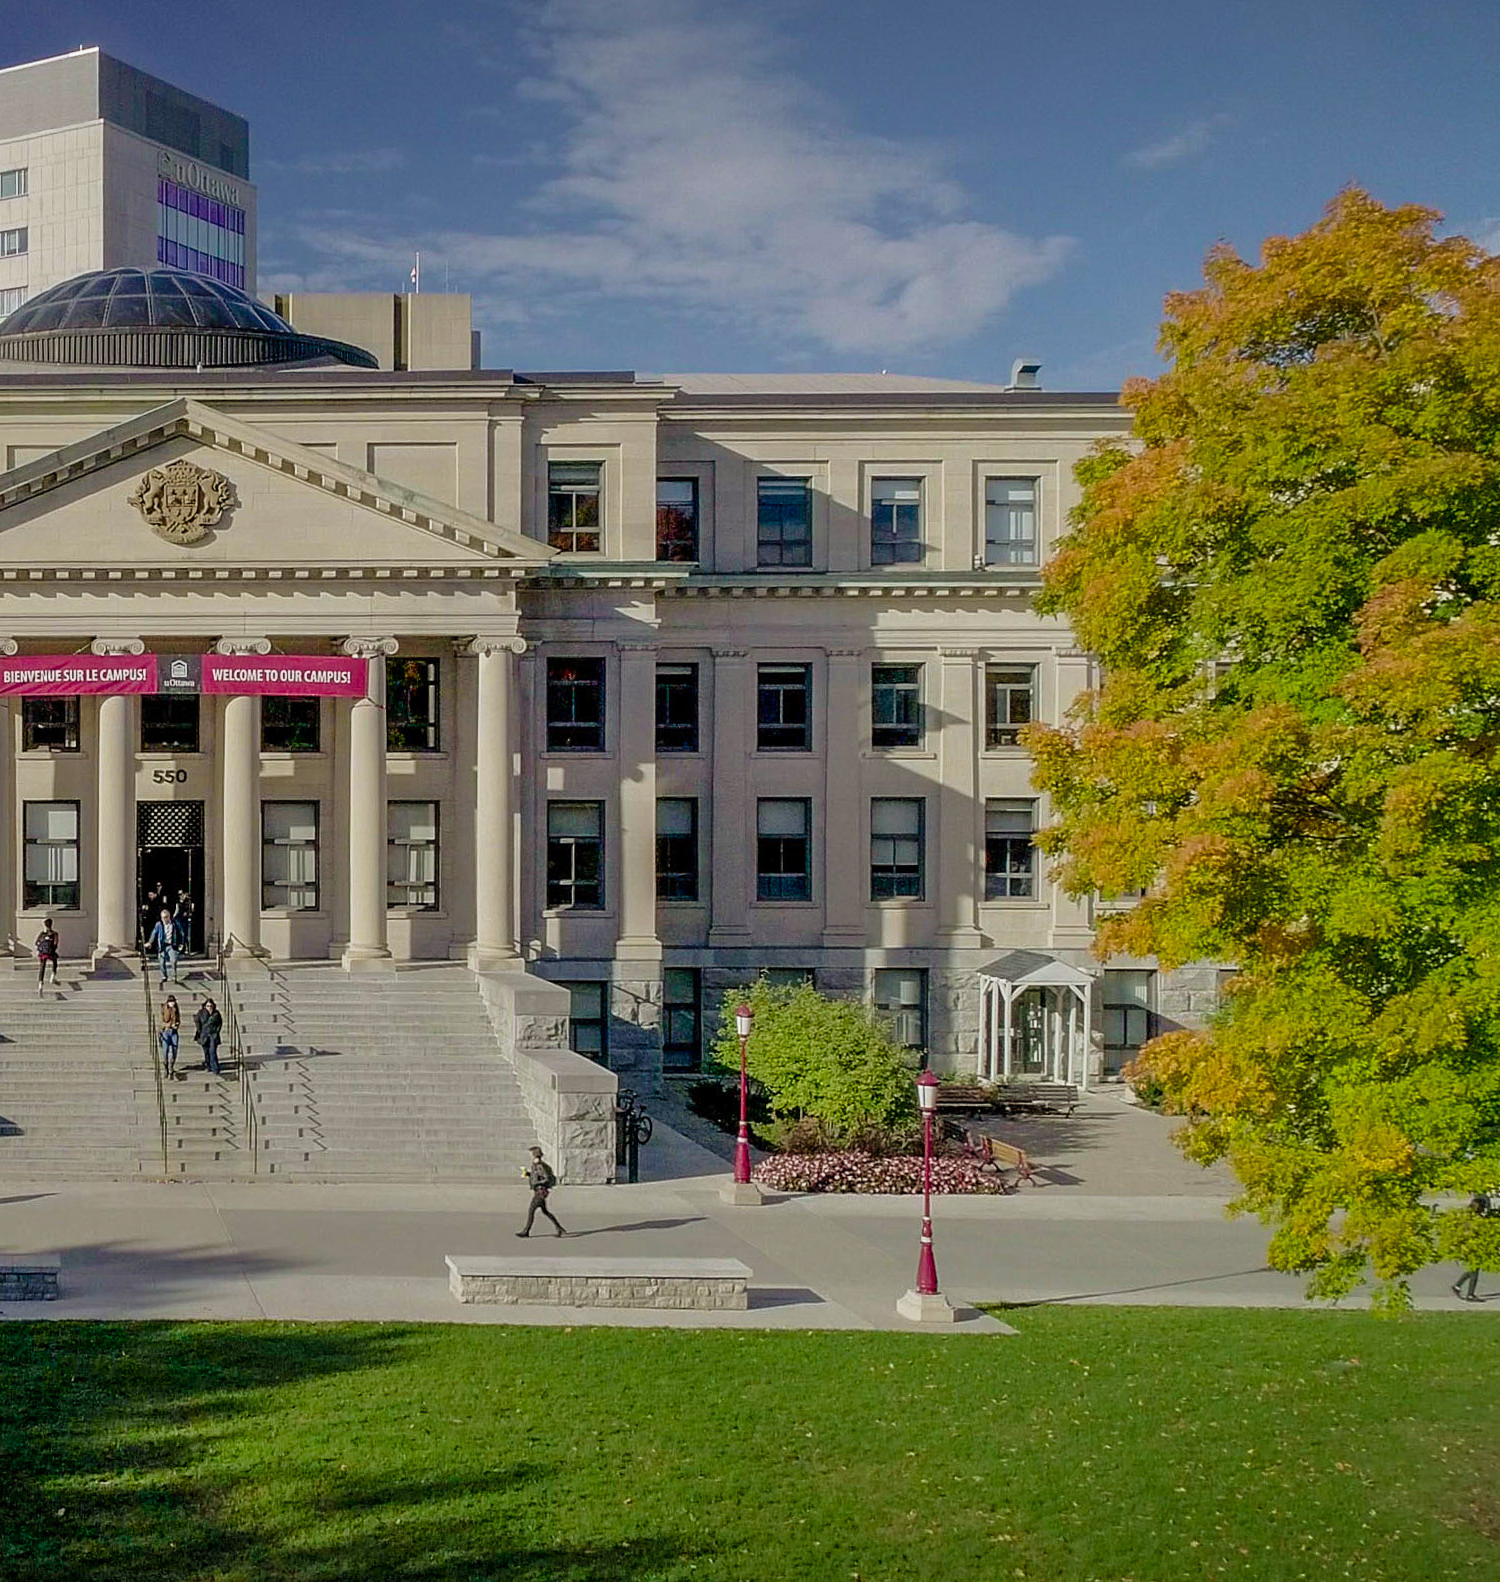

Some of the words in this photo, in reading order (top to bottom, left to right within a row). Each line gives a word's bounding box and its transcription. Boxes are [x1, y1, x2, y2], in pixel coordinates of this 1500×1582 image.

[175, 162, 240, 205] uOttawa
[3, 669, 62, 683] BIENVENUE
[63, 669, 84, 682] SUR
[86, 669, 98, 681] LE
[100, 668, 147, 681] CAMPUS!
[212, 668, 263, 682] WELCOME
[265, 669, 278, 682] TO
[280, 669, 302, 682] OUR
[304, 670, 351, 684] CAMPUS!
[152, 769, 188, 784] 550
